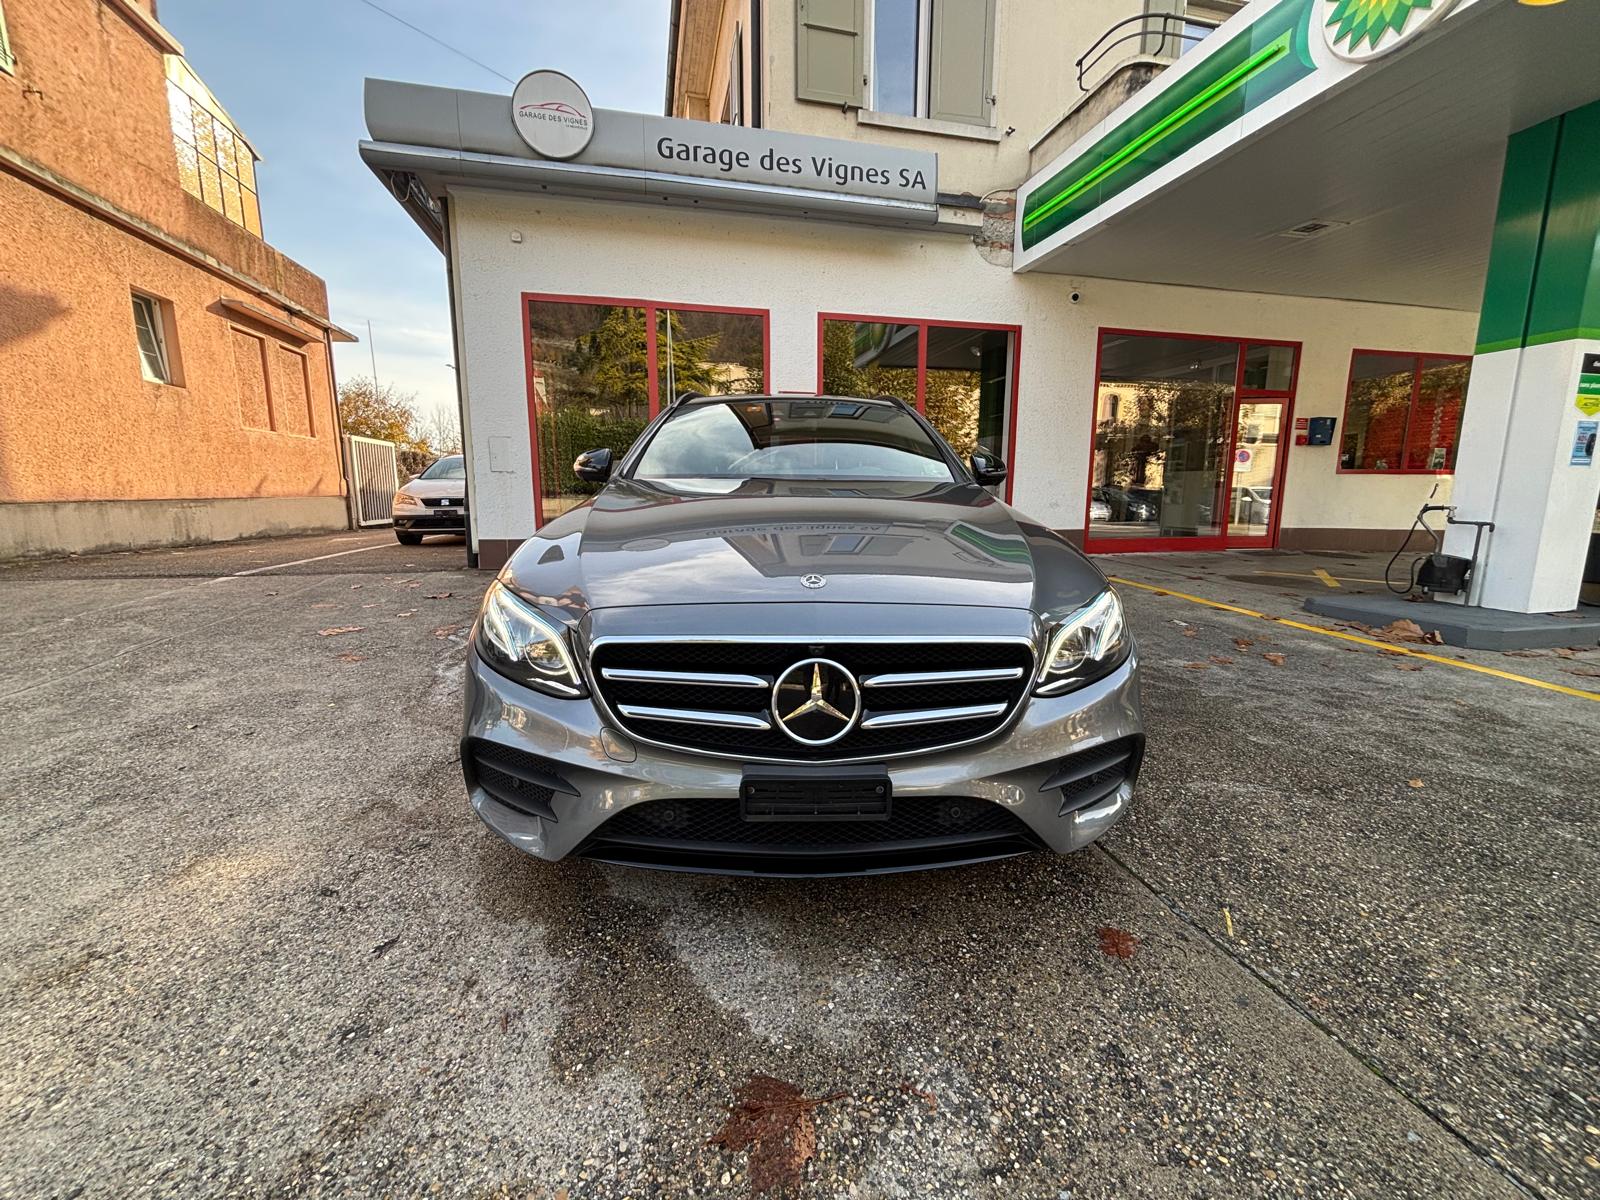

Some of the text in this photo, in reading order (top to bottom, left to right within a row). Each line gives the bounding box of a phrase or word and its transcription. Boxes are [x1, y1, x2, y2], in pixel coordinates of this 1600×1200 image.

[519, 111, 588, 126] GARAGE DES VIGNES
[656, 137, 927, 190] Garage des Vignes SA
